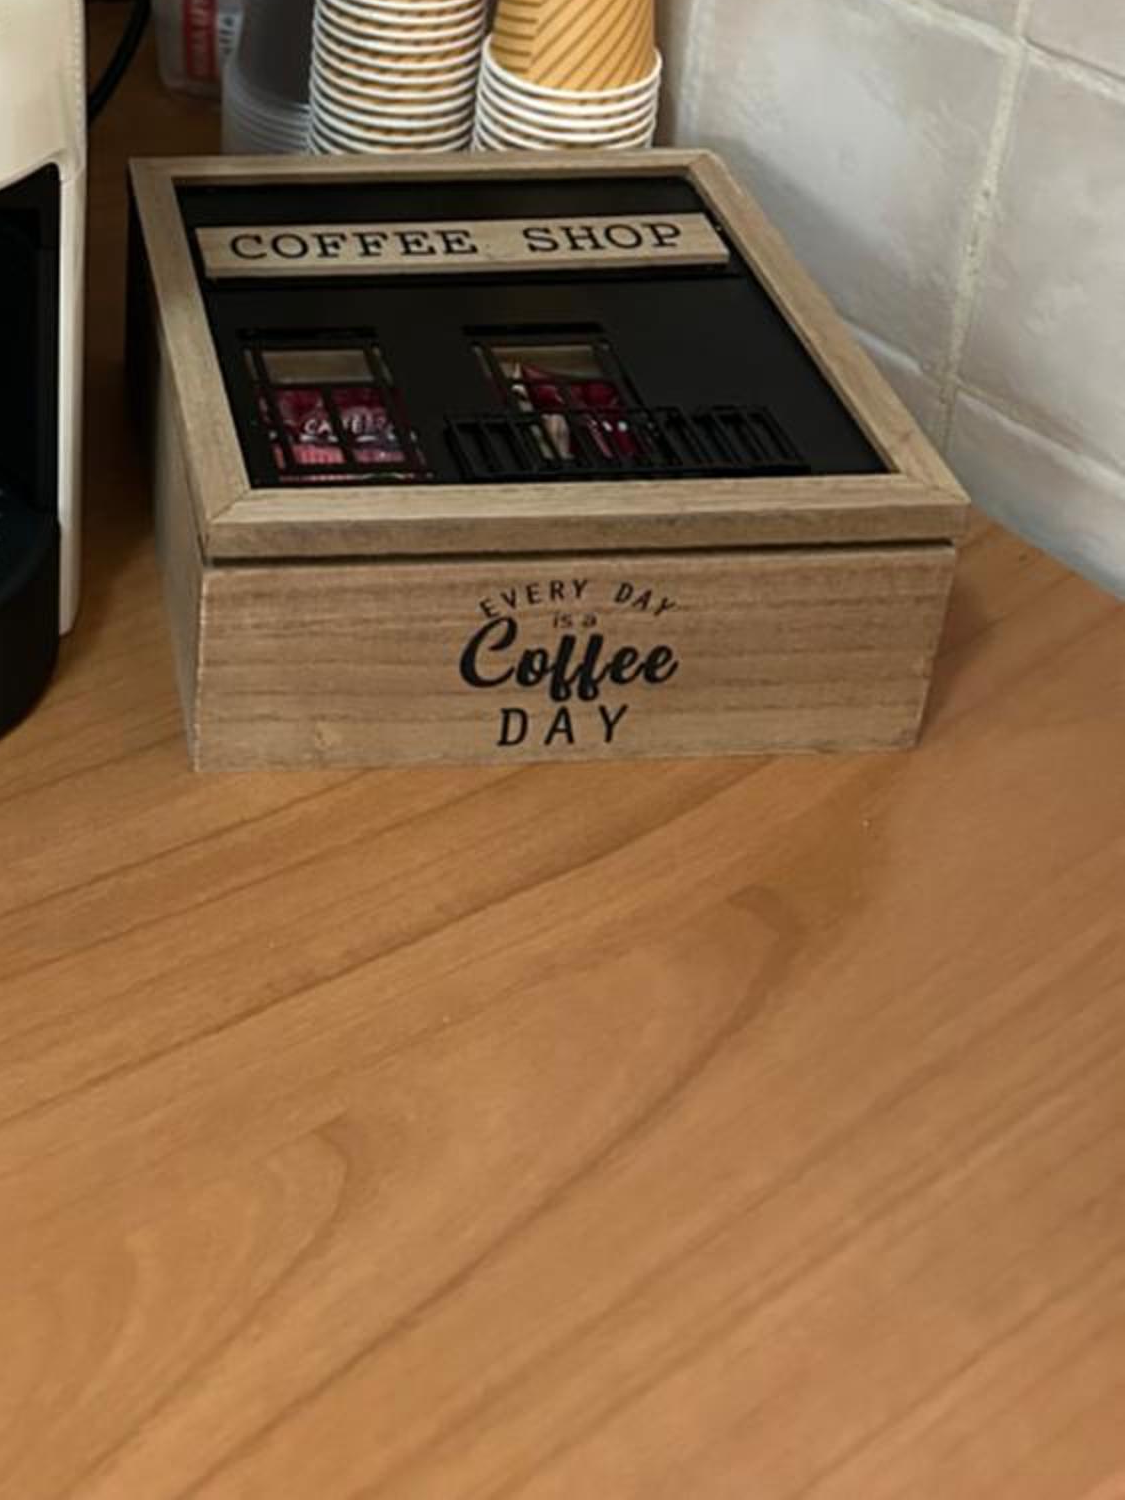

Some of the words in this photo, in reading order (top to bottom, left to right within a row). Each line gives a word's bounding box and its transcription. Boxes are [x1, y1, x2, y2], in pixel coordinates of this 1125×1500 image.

[230, 229, 479, 260] COFFEE
[522, 221, 683, 254] SHOP
[479, 578, 589, 619] EVERY
[614, 581, 678, 617] DAY
[581, 612, 598, 628] a
[459, 616, 679, 702] Coffee
[497, 703, 629, 747] DAY
